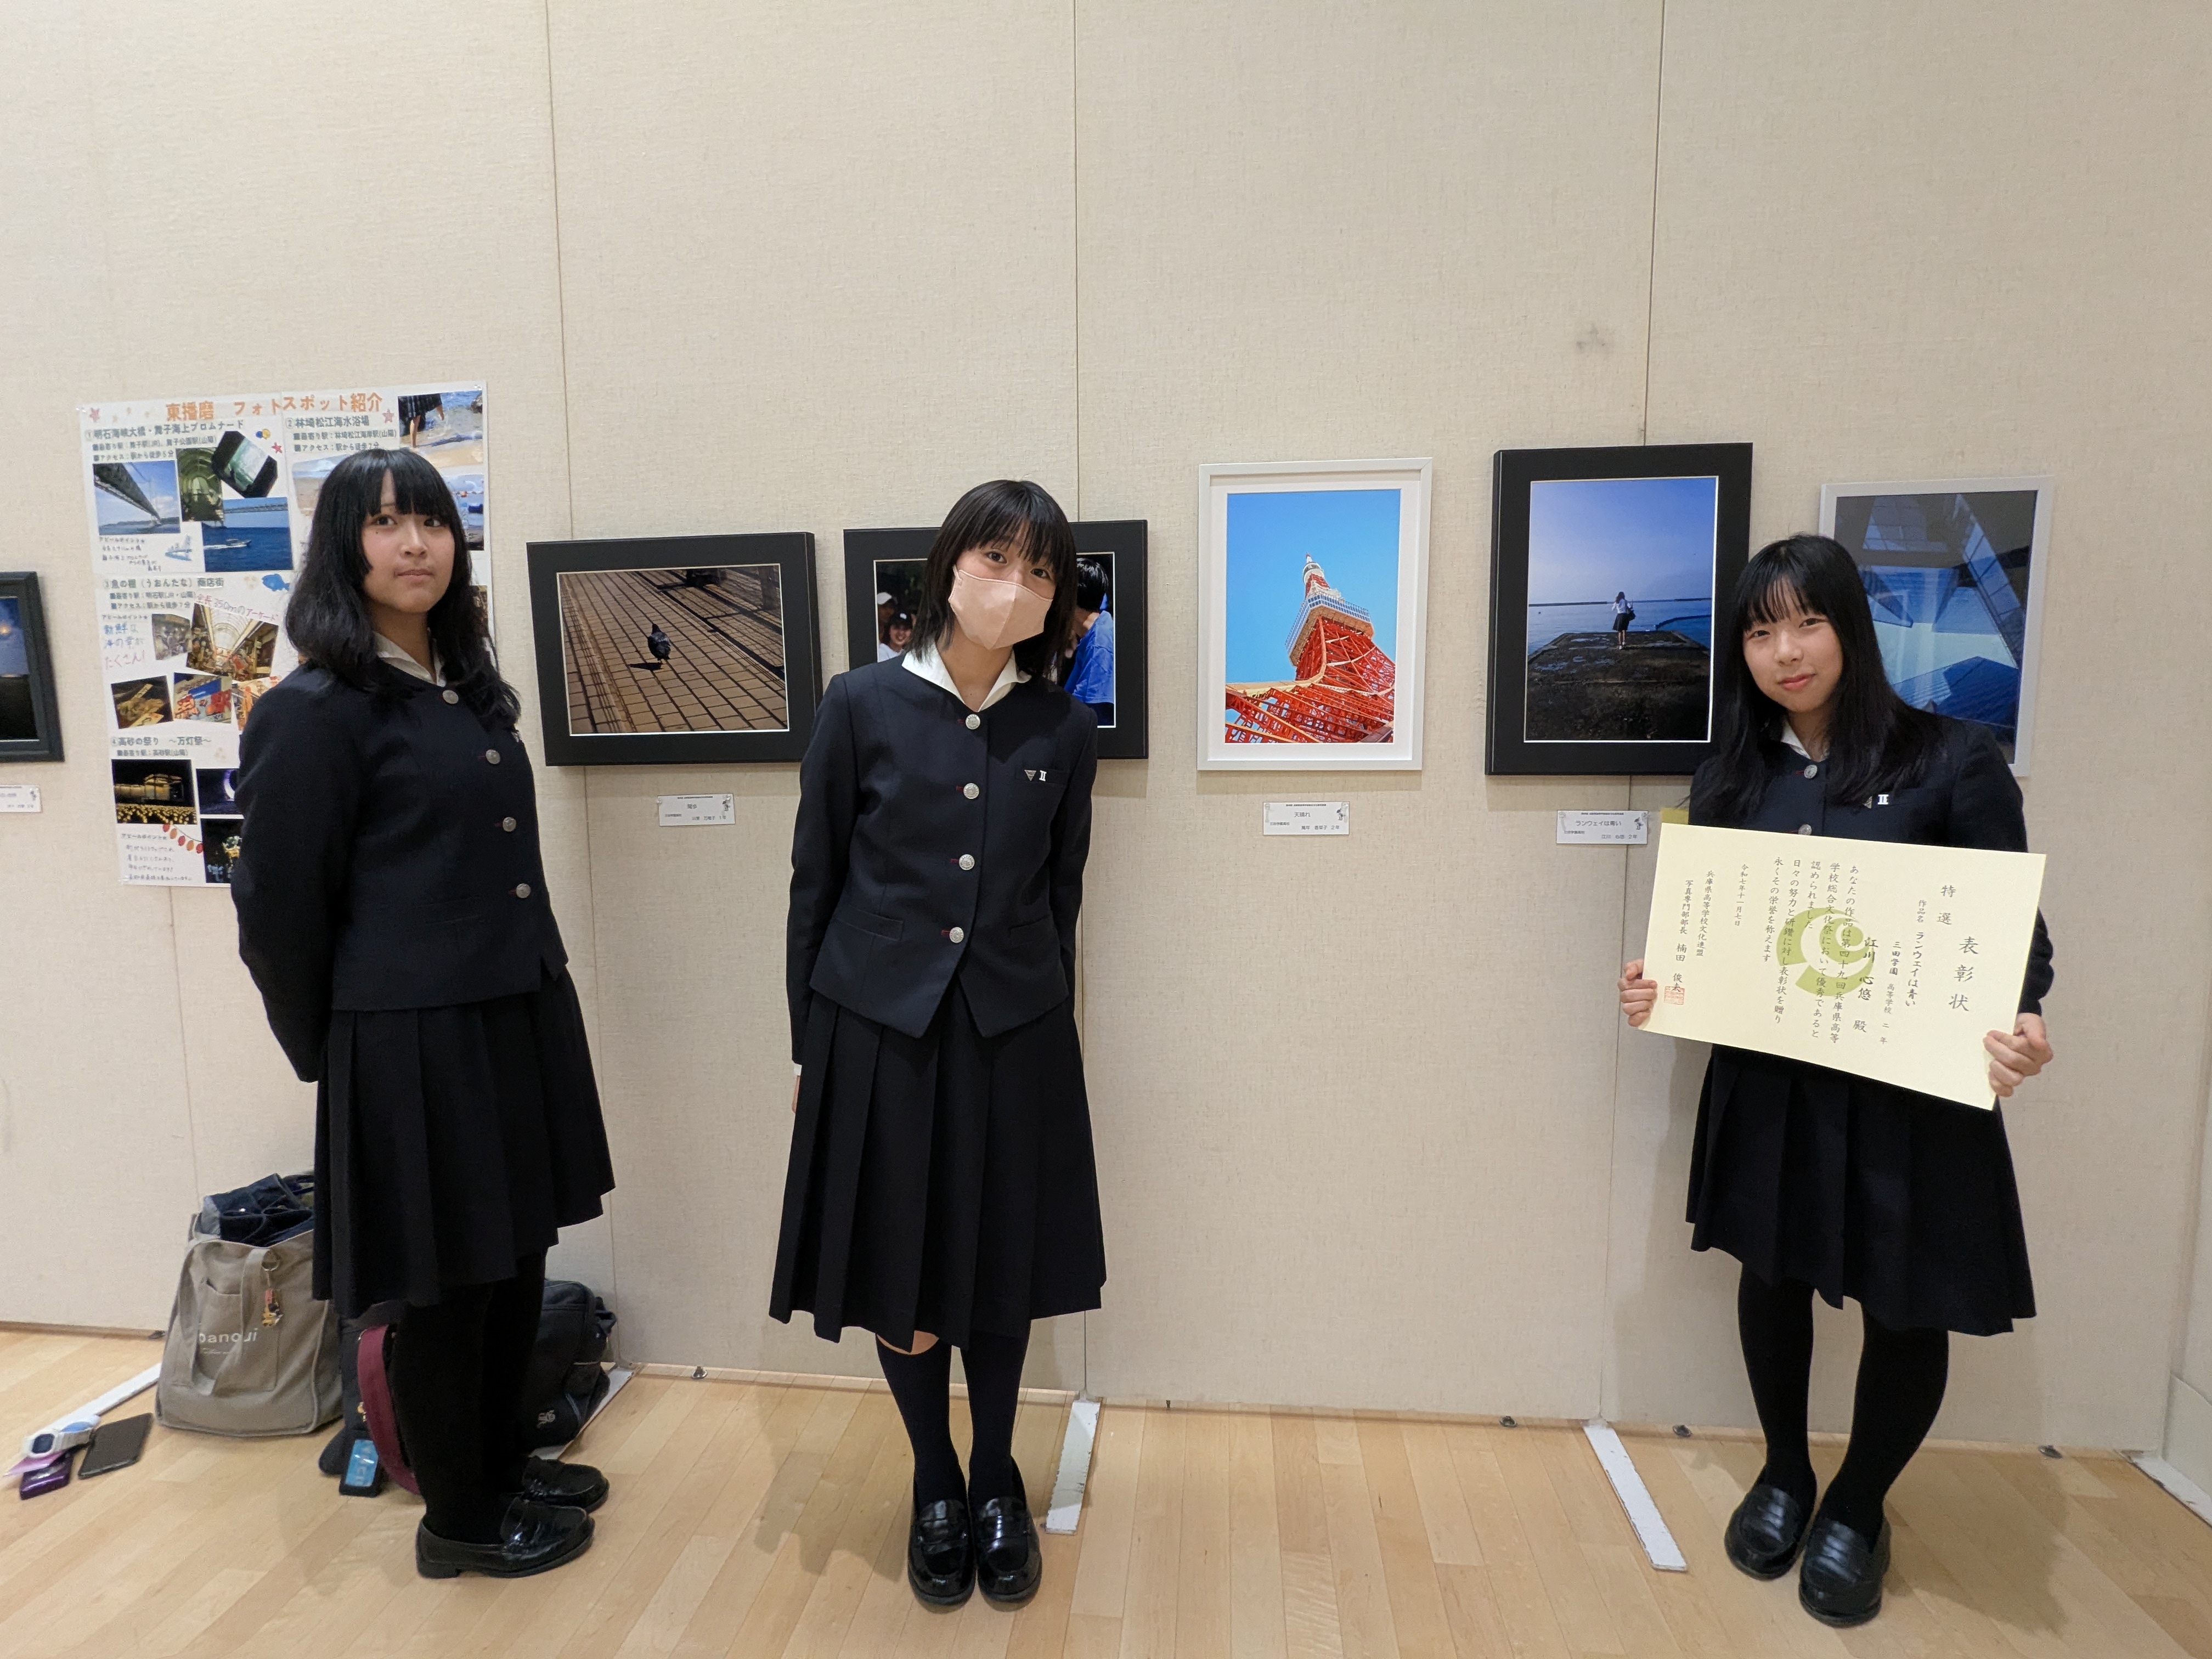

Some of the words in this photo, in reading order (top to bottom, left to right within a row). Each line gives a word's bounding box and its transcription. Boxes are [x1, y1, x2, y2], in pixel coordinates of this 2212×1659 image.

[166, 401, 215, 421] 東播磨
[1679, 880, 1694, 934] 写真専門部部長
[1696, 870, 1715, 956] 兵庫県高等学校文化連盟
[1735, 864, 1748, 926] 令和七年十一月七日
[1763, 857, 1784, 962] 永くその栄誉を称えます
[1805, 861, 1821, 929] 認められました
[1917, 900, 1927, 923] 作品名
[1937, 885, 1956, 925] 特選
[1812, 863, 1840, 1038] 学校総合文化祭において優秀であると
[1830, 866, 1859, 1043] あなたの作品は第四十九回兵庫県高等
[1863, 937, 1878, 963] 江川
[1949, 936, 1979, 1011] 表彰状
[1858, 976, 1875, 1001] 心悠
[1853, 1020, 1867, 1032] 殿
